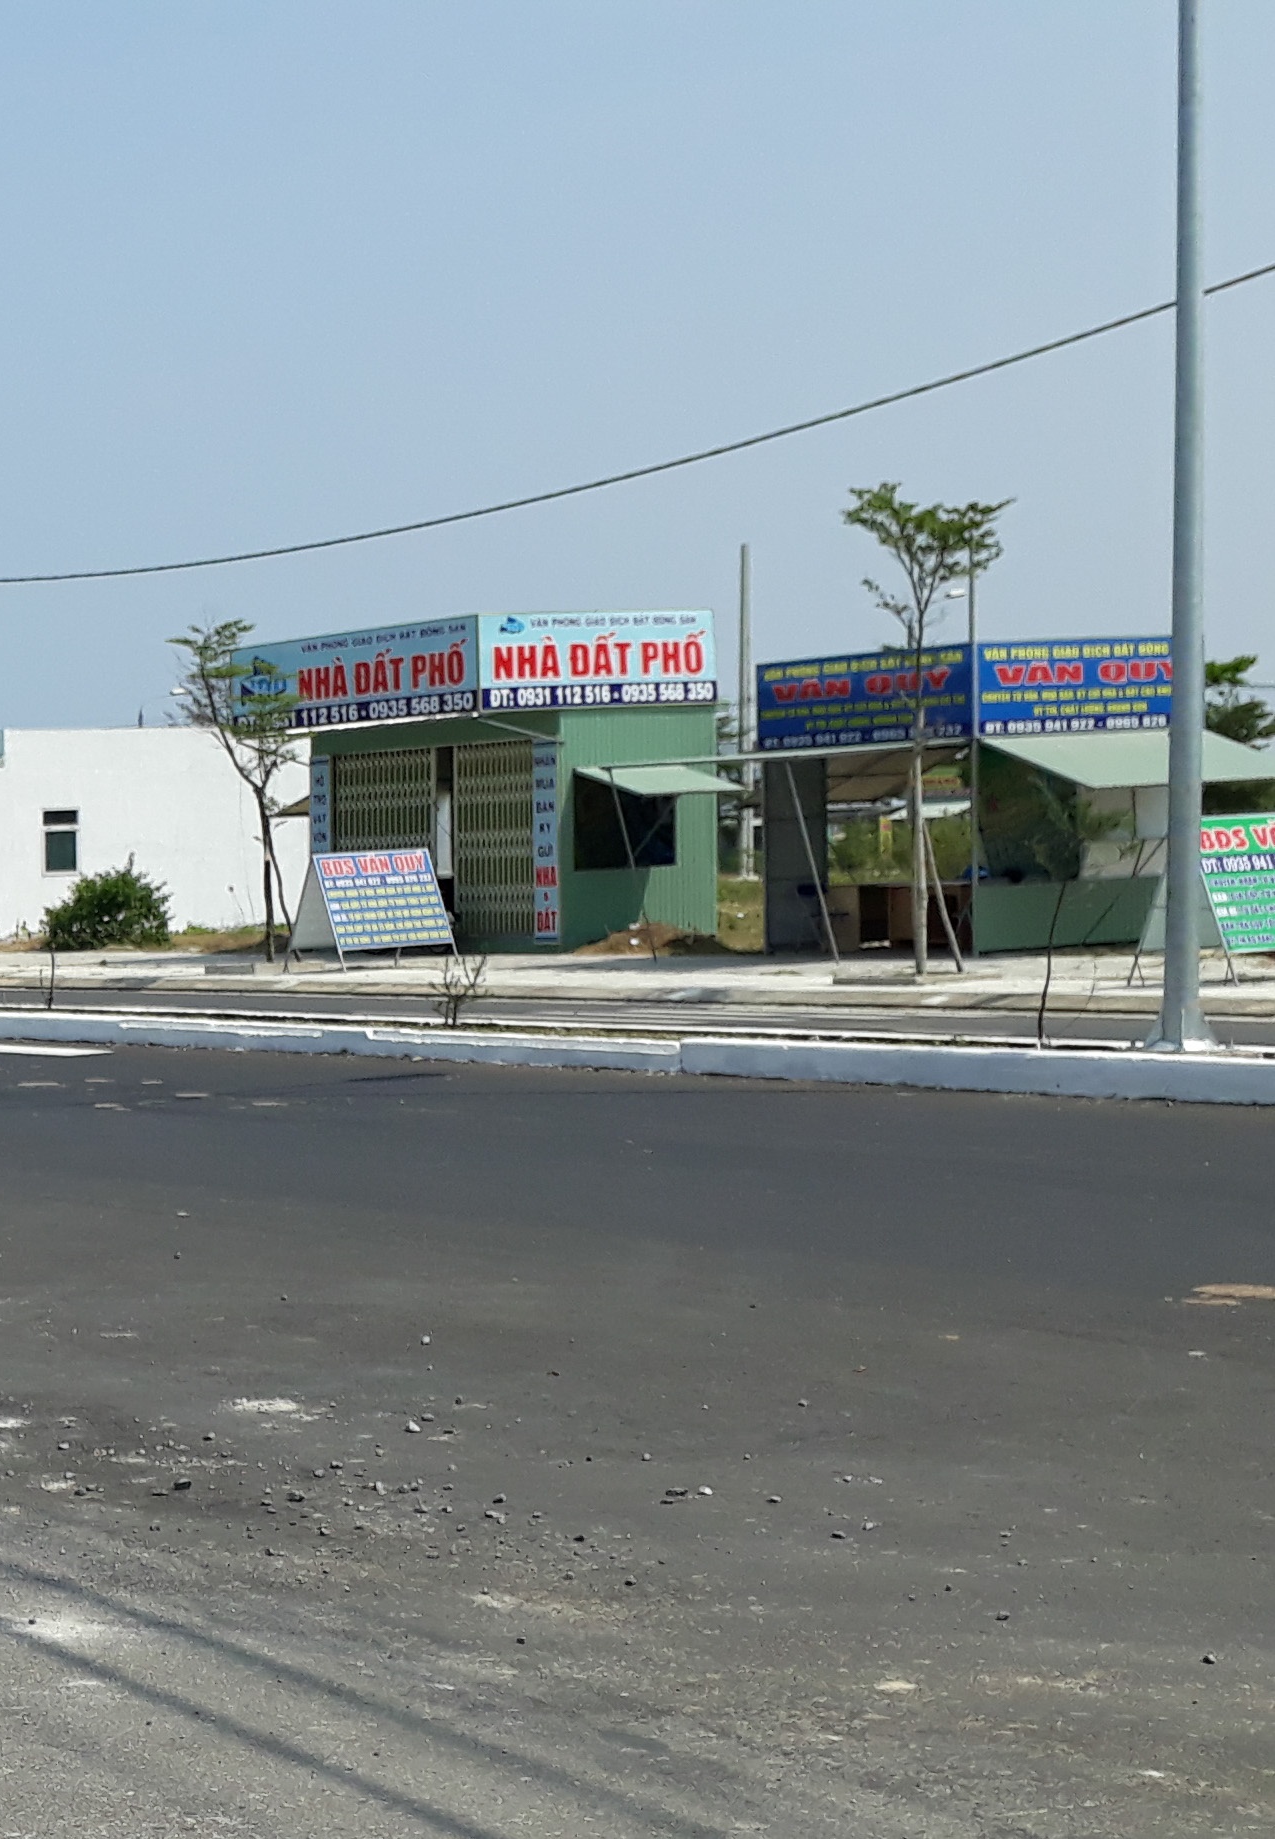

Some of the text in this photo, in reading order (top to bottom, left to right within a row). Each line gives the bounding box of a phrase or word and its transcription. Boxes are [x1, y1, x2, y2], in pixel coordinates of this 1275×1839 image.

[297, 638, 468, 702] NHÀ ĐẤT PHỐ
[493, 630, 707, 680] NHÀ ĐẤT PHỐ
[301, 707, 326, 726] 112
[330, 704, 359, 722] 516
[369, 698, 408, 720] 0935
[410, 696, 440, 716] 568
[444, 692, 474, 712] 350
[518, 688, 551, 707] 0931
[556, 687, 582, 705] 112
[585, 685, 611, 704] 516
[621, 684, 656, 702] 0935
[658, 683, 684, 701] 568
[687, 682, 714, 700] 350
